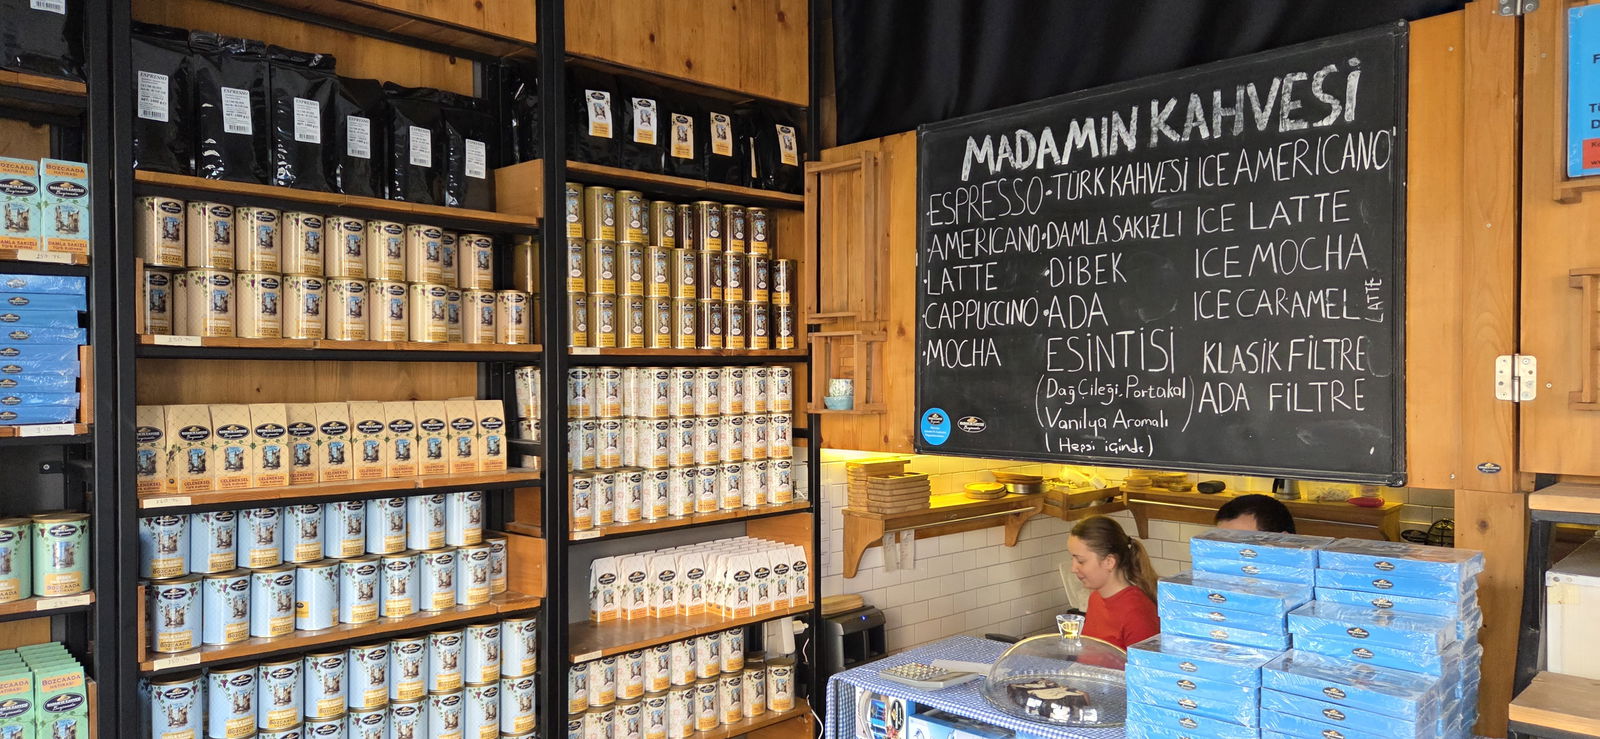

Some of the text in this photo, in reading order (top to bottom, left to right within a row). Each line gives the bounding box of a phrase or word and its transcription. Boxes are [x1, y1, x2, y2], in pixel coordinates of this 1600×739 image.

[140, 72, 168, 81] ESPRESSO
[961, 57, 1361, 181] MADAMIN KAHVESİ
[45, 163, 85, 174] BOZCAADA
[1198, 129, 1391, 189] ICE AMERICANO
[1051, 157, 1189, 201] TÜRK KAHVESİ
[930, 176, 1043, 226] ESPRESSO
[1197, 189, 1350, 236] ICE LATTE
[928, 224, 1040, 263] AMERICANO
[1047, 210, 1182, 249] DAMLA SAKIZLI
[1049, 252, 1127, 287] DİBEK
[1195, 233, 1369, 279] ICE MOCHA
[927, 262, 998, 295] LATTE
[924, 297, 1039, 330] CAPPUCCINO
[1048, 292, 1109, 330] ADA
[1194, 287, 1361, 321] ICE CARAMEL
[1364, 277, 1384, 323] LATTE
[926, 338, 1002, 369] MOCHA
[1047, 326, 1175, 374] ESİNTİSİ
[1203, 335, 1366, 374] KLASİK FİLTRE
[1198, 378, 1366, 414] ADA FİLTRE
[1045, 406, 1107, 437] Vanilya
[42, 674, 81, 687] BOZCAADA
